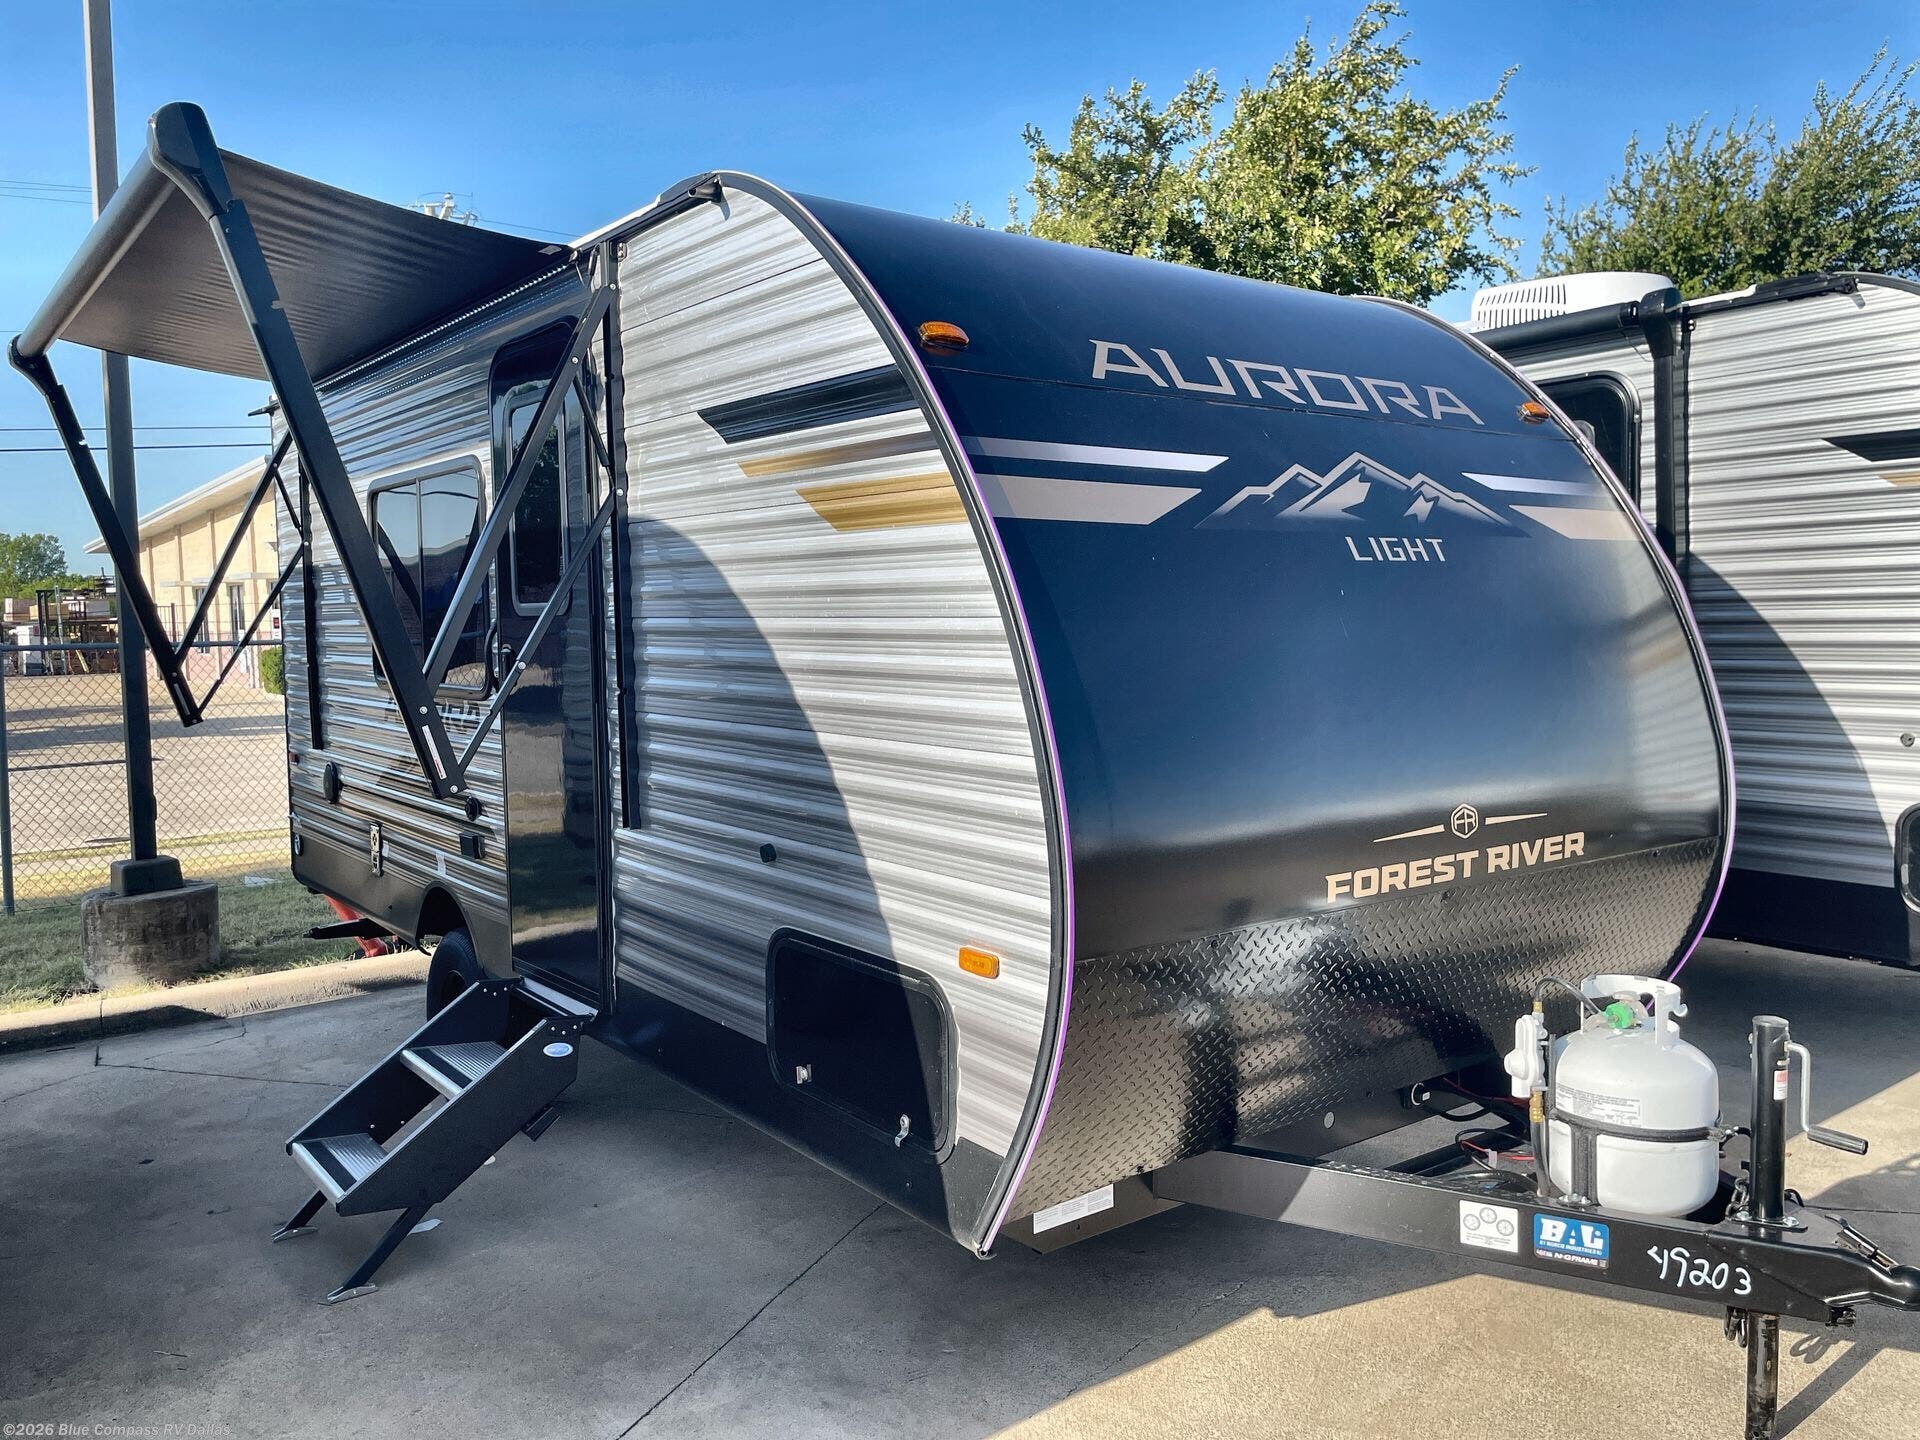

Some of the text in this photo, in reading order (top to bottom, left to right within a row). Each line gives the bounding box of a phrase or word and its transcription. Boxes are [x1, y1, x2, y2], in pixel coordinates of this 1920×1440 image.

[1089, 338, 1485, 426] AURORA
[1344, 535, 1447, 563] LIGHT
[1325, 831, 1586, 904] FOREST RIVER
[1646, 1245, 1752, 1295] 49203
